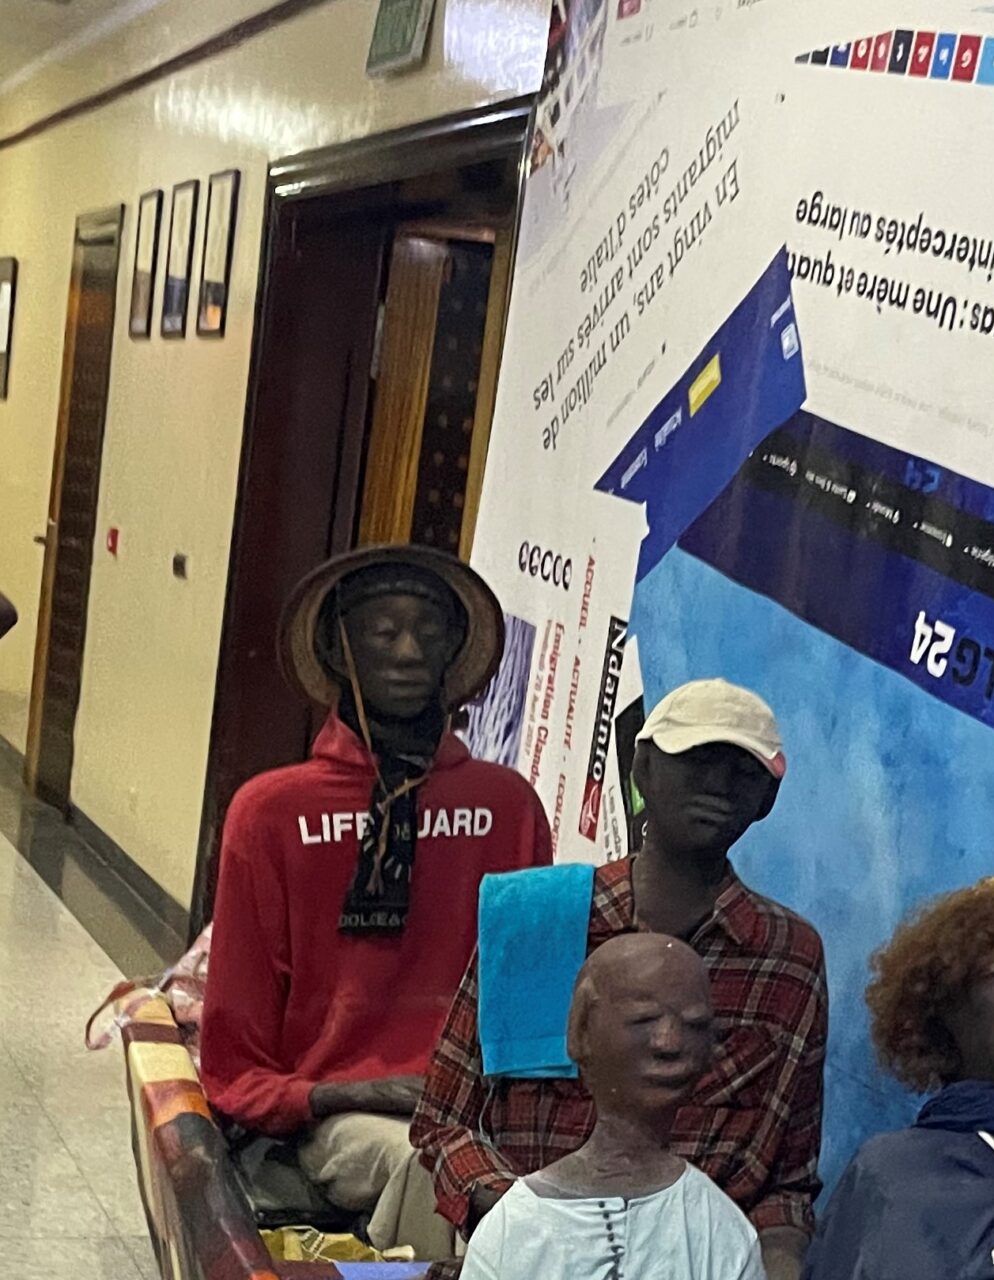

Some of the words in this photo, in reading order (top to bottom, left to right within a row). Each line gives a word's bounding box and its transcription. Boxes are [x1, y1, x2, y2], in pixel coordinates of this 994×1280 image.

[629, 148, 669, 220] côtes
[663, 99, 741, 223] migrants
[715, 158, 741, 204] En
[795, 190, 848, 241] large
[850, 210, 871, 239] au
[626, 219, 661, 279] sont
[668, 206, 713, 272] vingt
[576, 263, 626, 346] arrivés
[632, 255, 666, 317] ans,
[837, 265, 853, 298] et
[857, 271, 910, 314] mère
[913, 287, 957, 331] Une
[556, 336, 575, 378] sur
[610, 320, 631, 354] un
[533, 368, 555, 411] les
[561, 338, 608, 425] million
[542, 416, 559, 450] de
